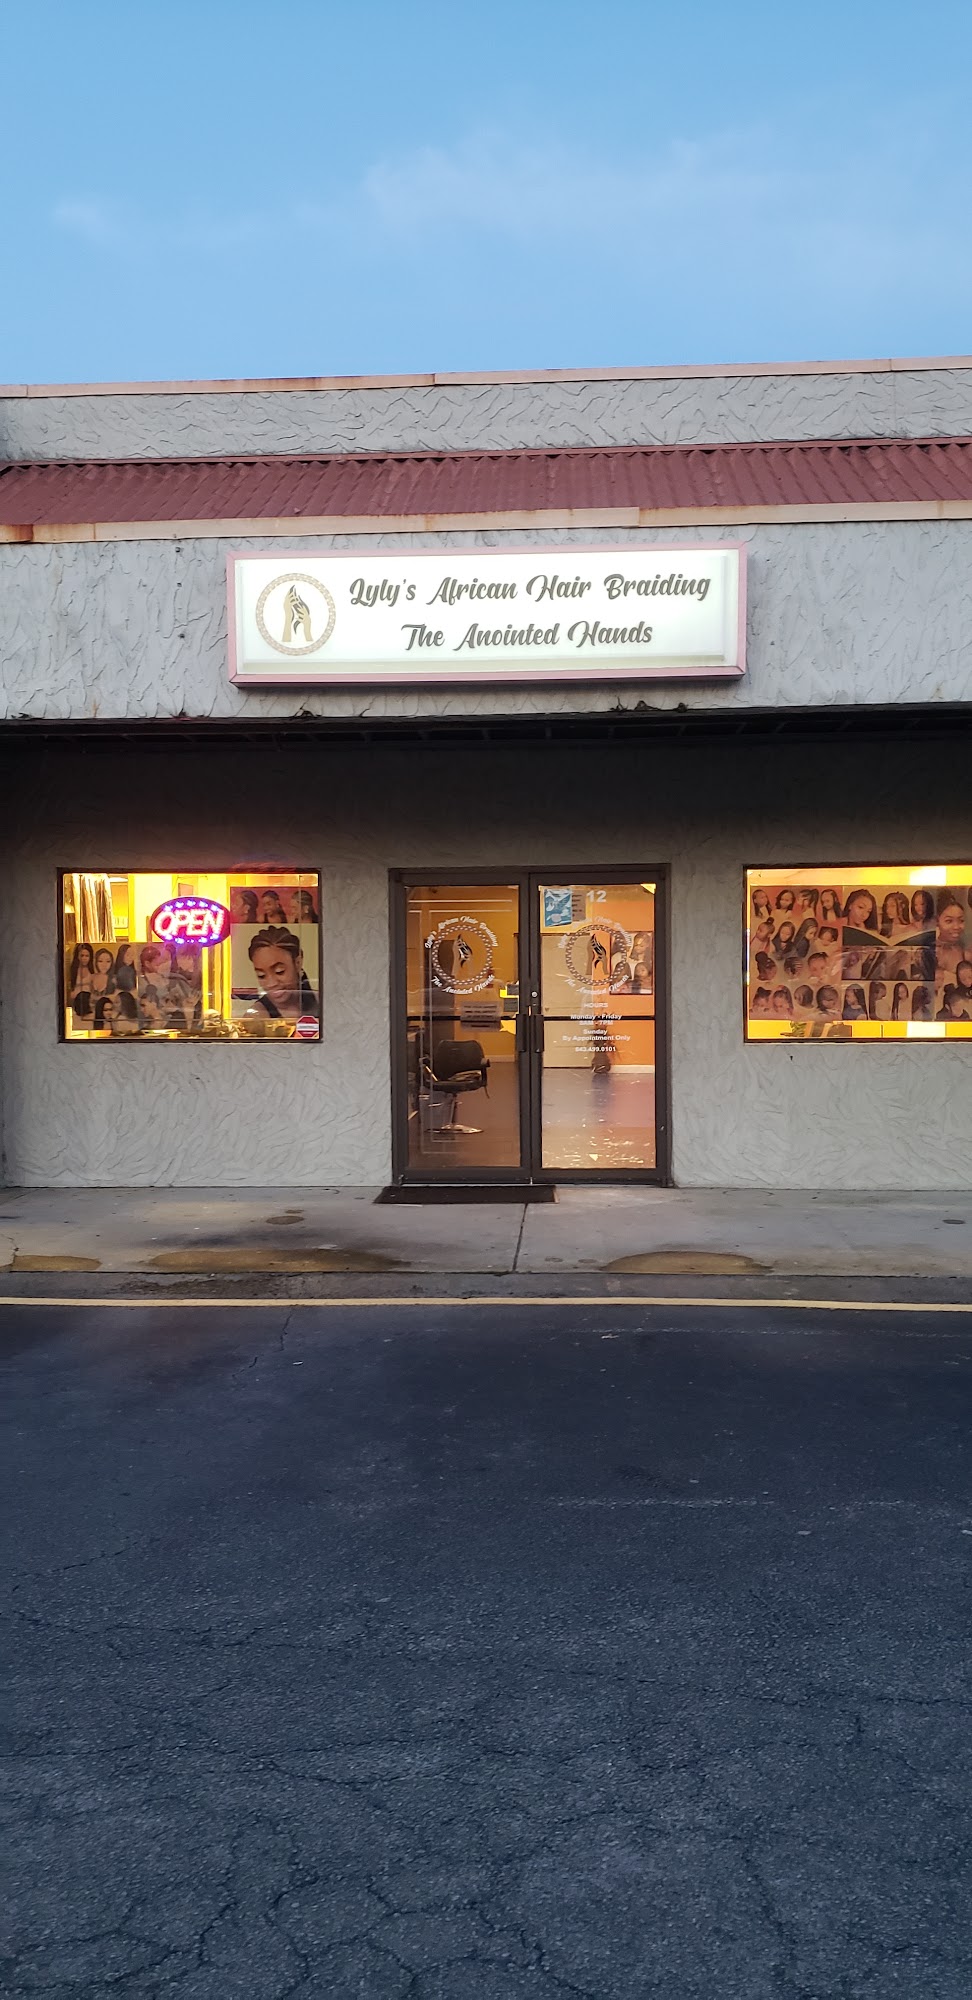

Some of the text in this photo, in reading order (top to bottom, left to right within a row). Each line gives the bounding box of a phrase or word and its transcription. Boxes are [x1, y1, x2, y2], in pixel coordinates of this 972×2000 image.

[350, 573, 711, 607] Lyly's African Hair Braiding
[401, 621, 653, 651] The Anointed Hands
[586, 890, 607, 903] 12
[154, 908, 224, 937] OPEN
